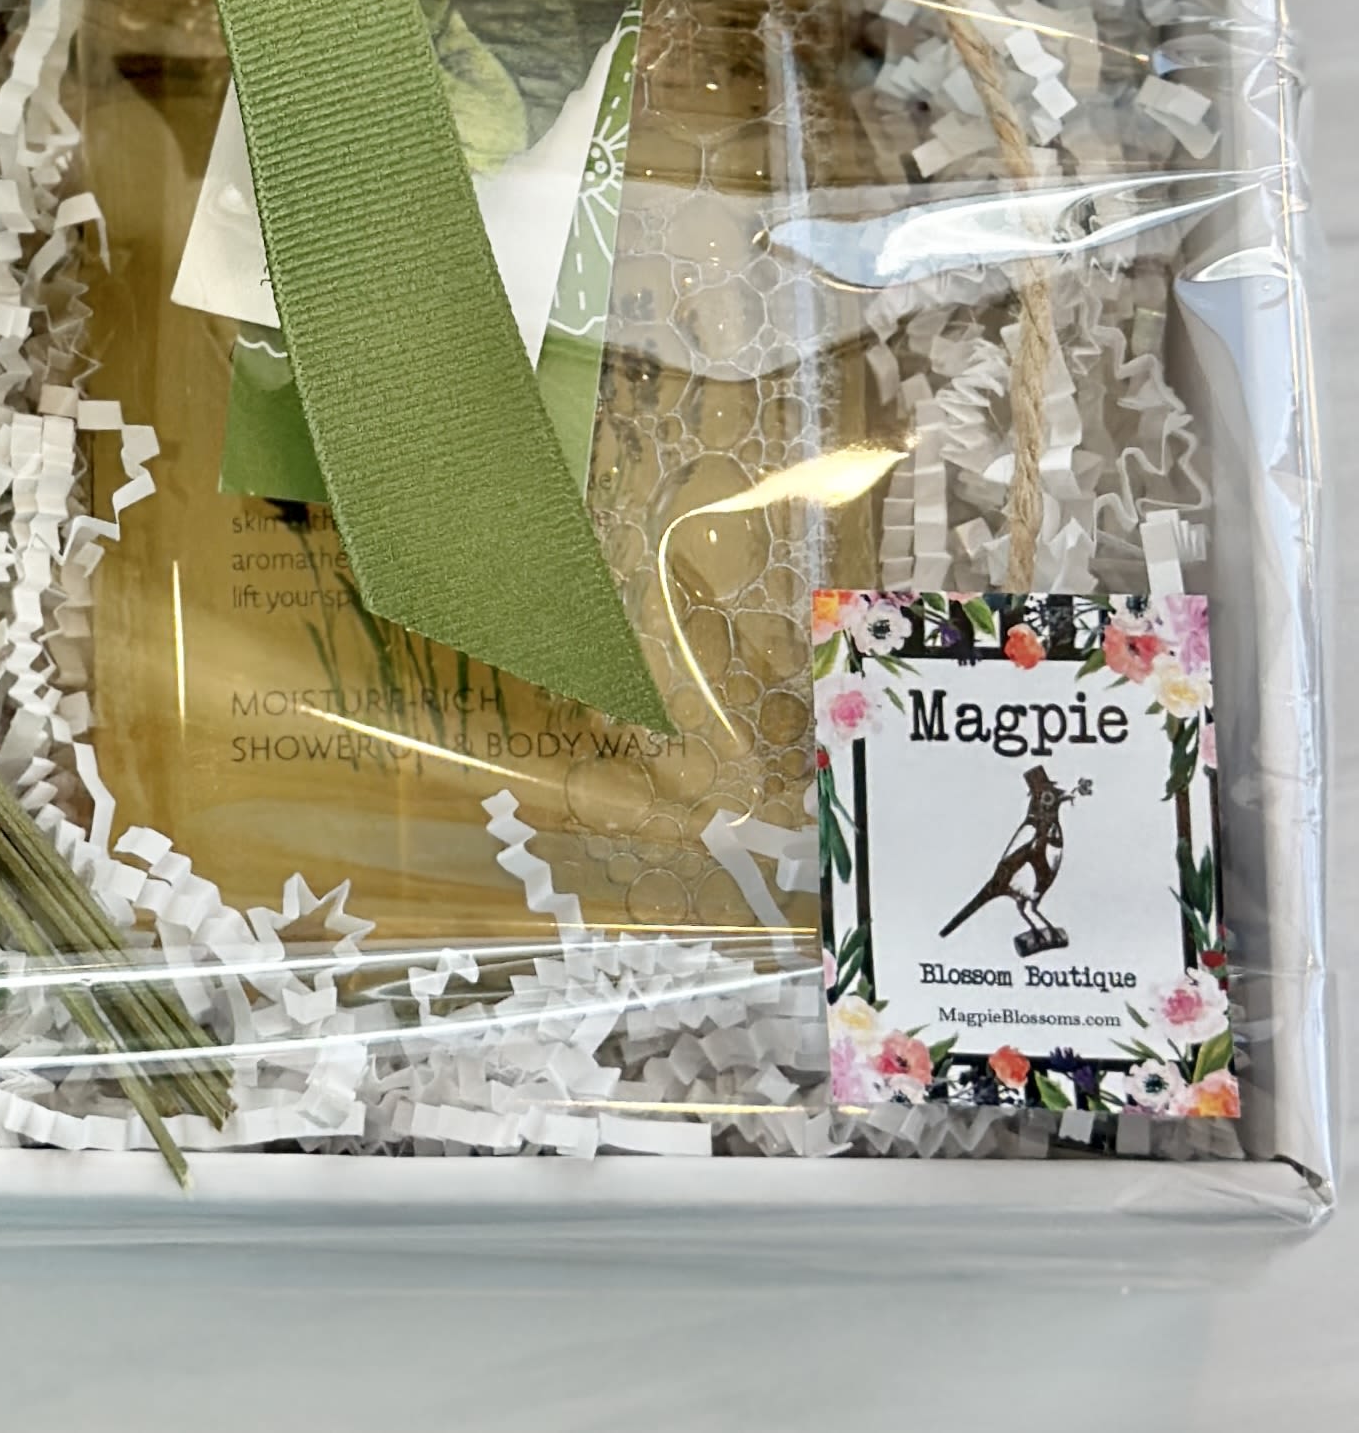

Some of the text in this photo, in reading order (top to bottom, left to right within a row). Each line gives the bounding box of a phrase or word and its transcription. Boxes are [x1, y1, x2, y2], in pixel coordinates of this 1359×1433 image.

[232, 509, 276, 534] skin
[232, 584, 260, 609] lift
[266, 589, 318, 614] your
[908, 689, 1129, 756] Magpie
[231, 734, 377, 763] SHOWER
[488, 732, 582, 758] BODY
[591, 732, 686, 758] WASH
[919, 963, 1137, 991] Blossom Boutique
[938, 1006, 1121, 1029] MagpieBlossoms.com
